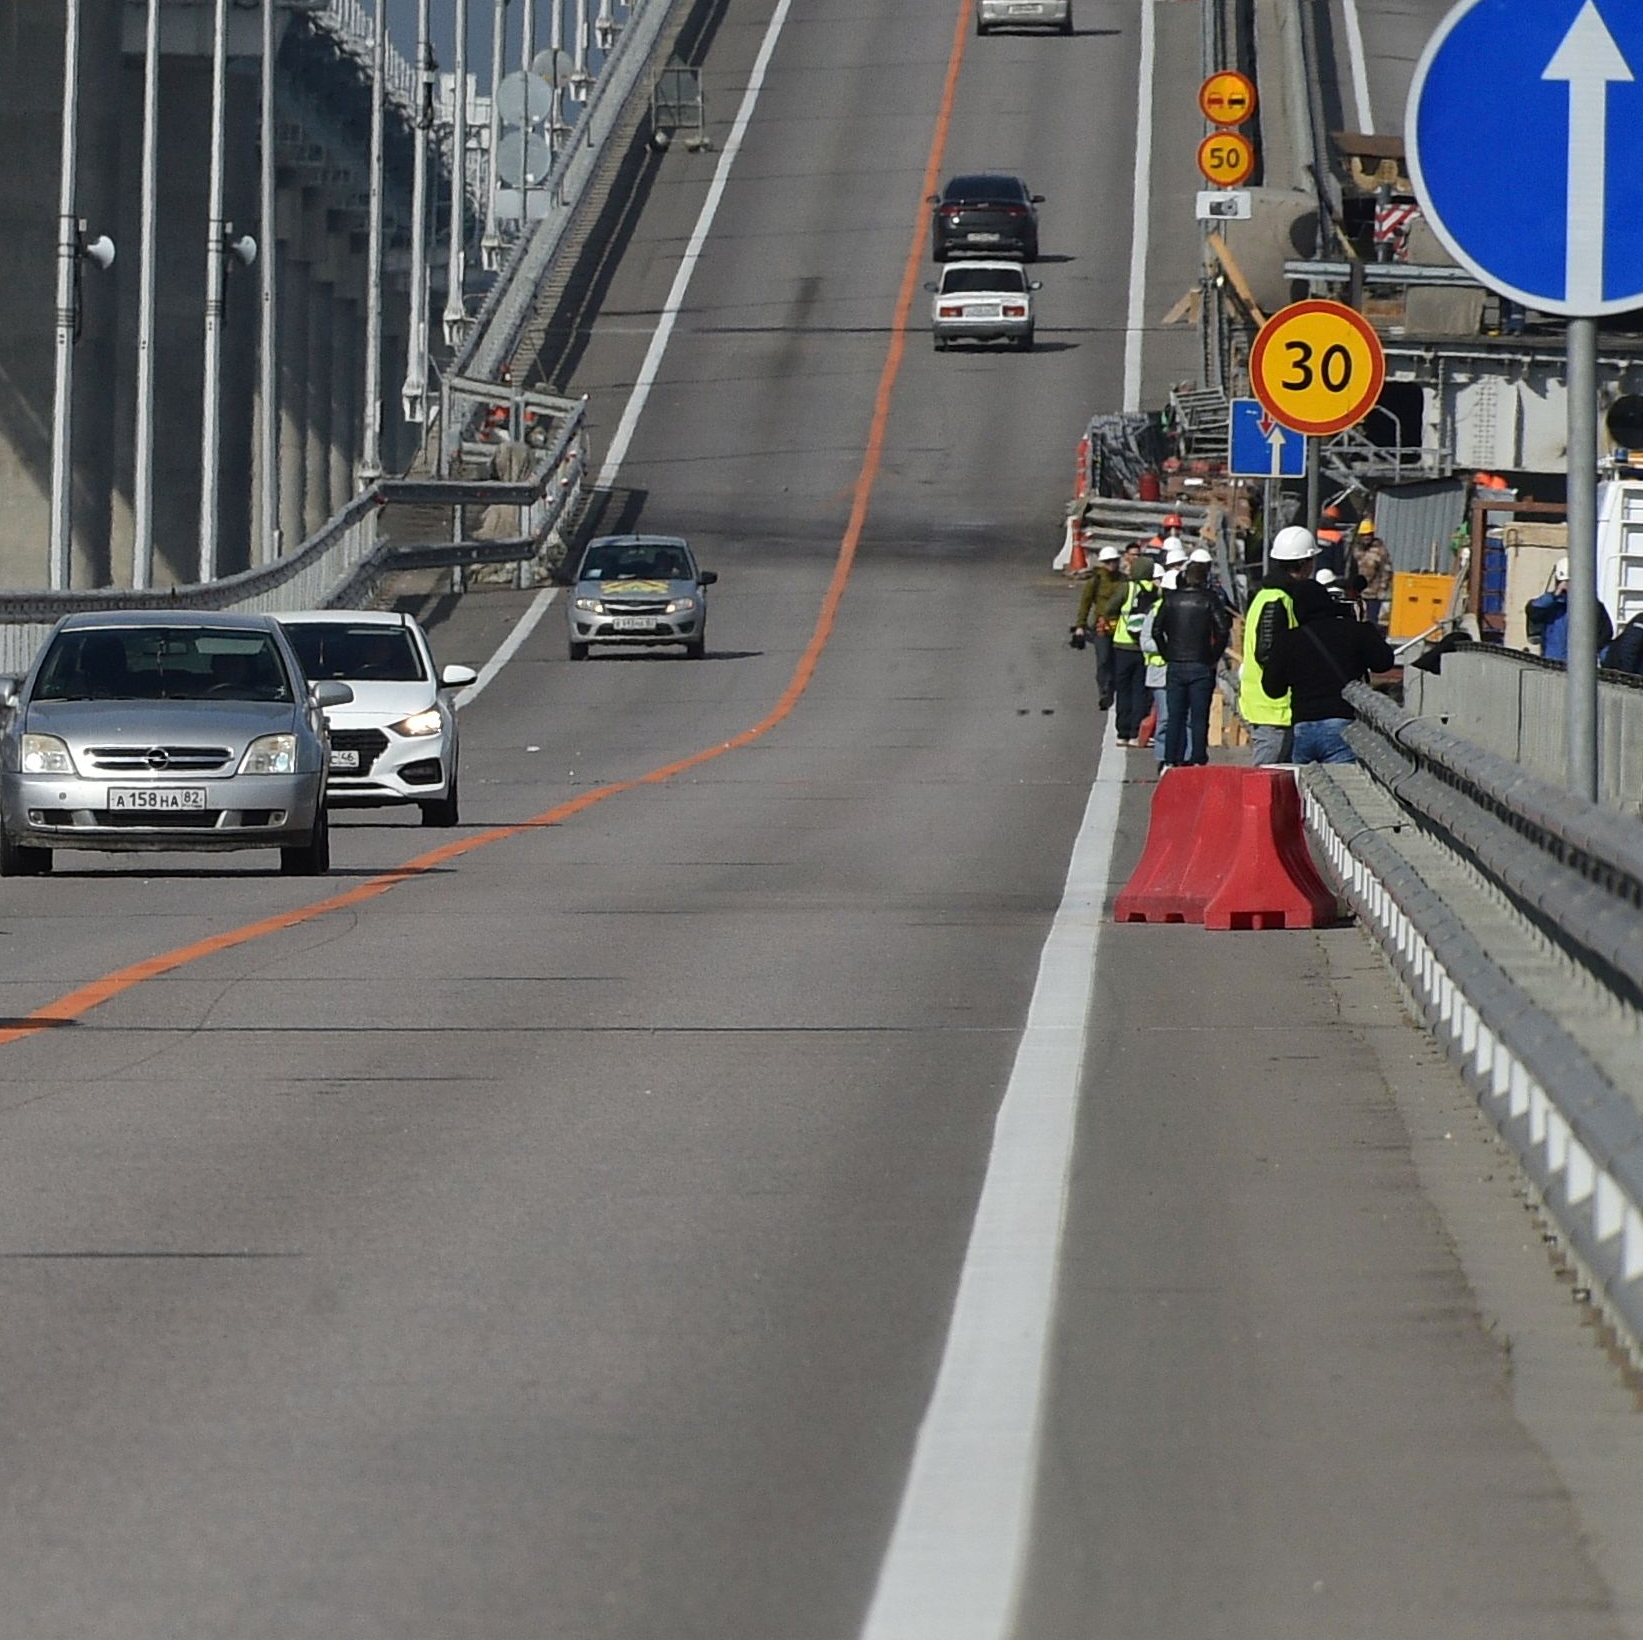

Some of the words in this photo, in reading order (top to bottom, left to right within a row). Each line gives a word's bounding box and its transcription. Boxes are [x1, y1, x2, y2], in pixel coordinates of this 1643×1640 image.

[1210, 148, 1240, 169] 50
[1282, 341, 1353, 393] 30
[183, 791, 200, 804] 82
